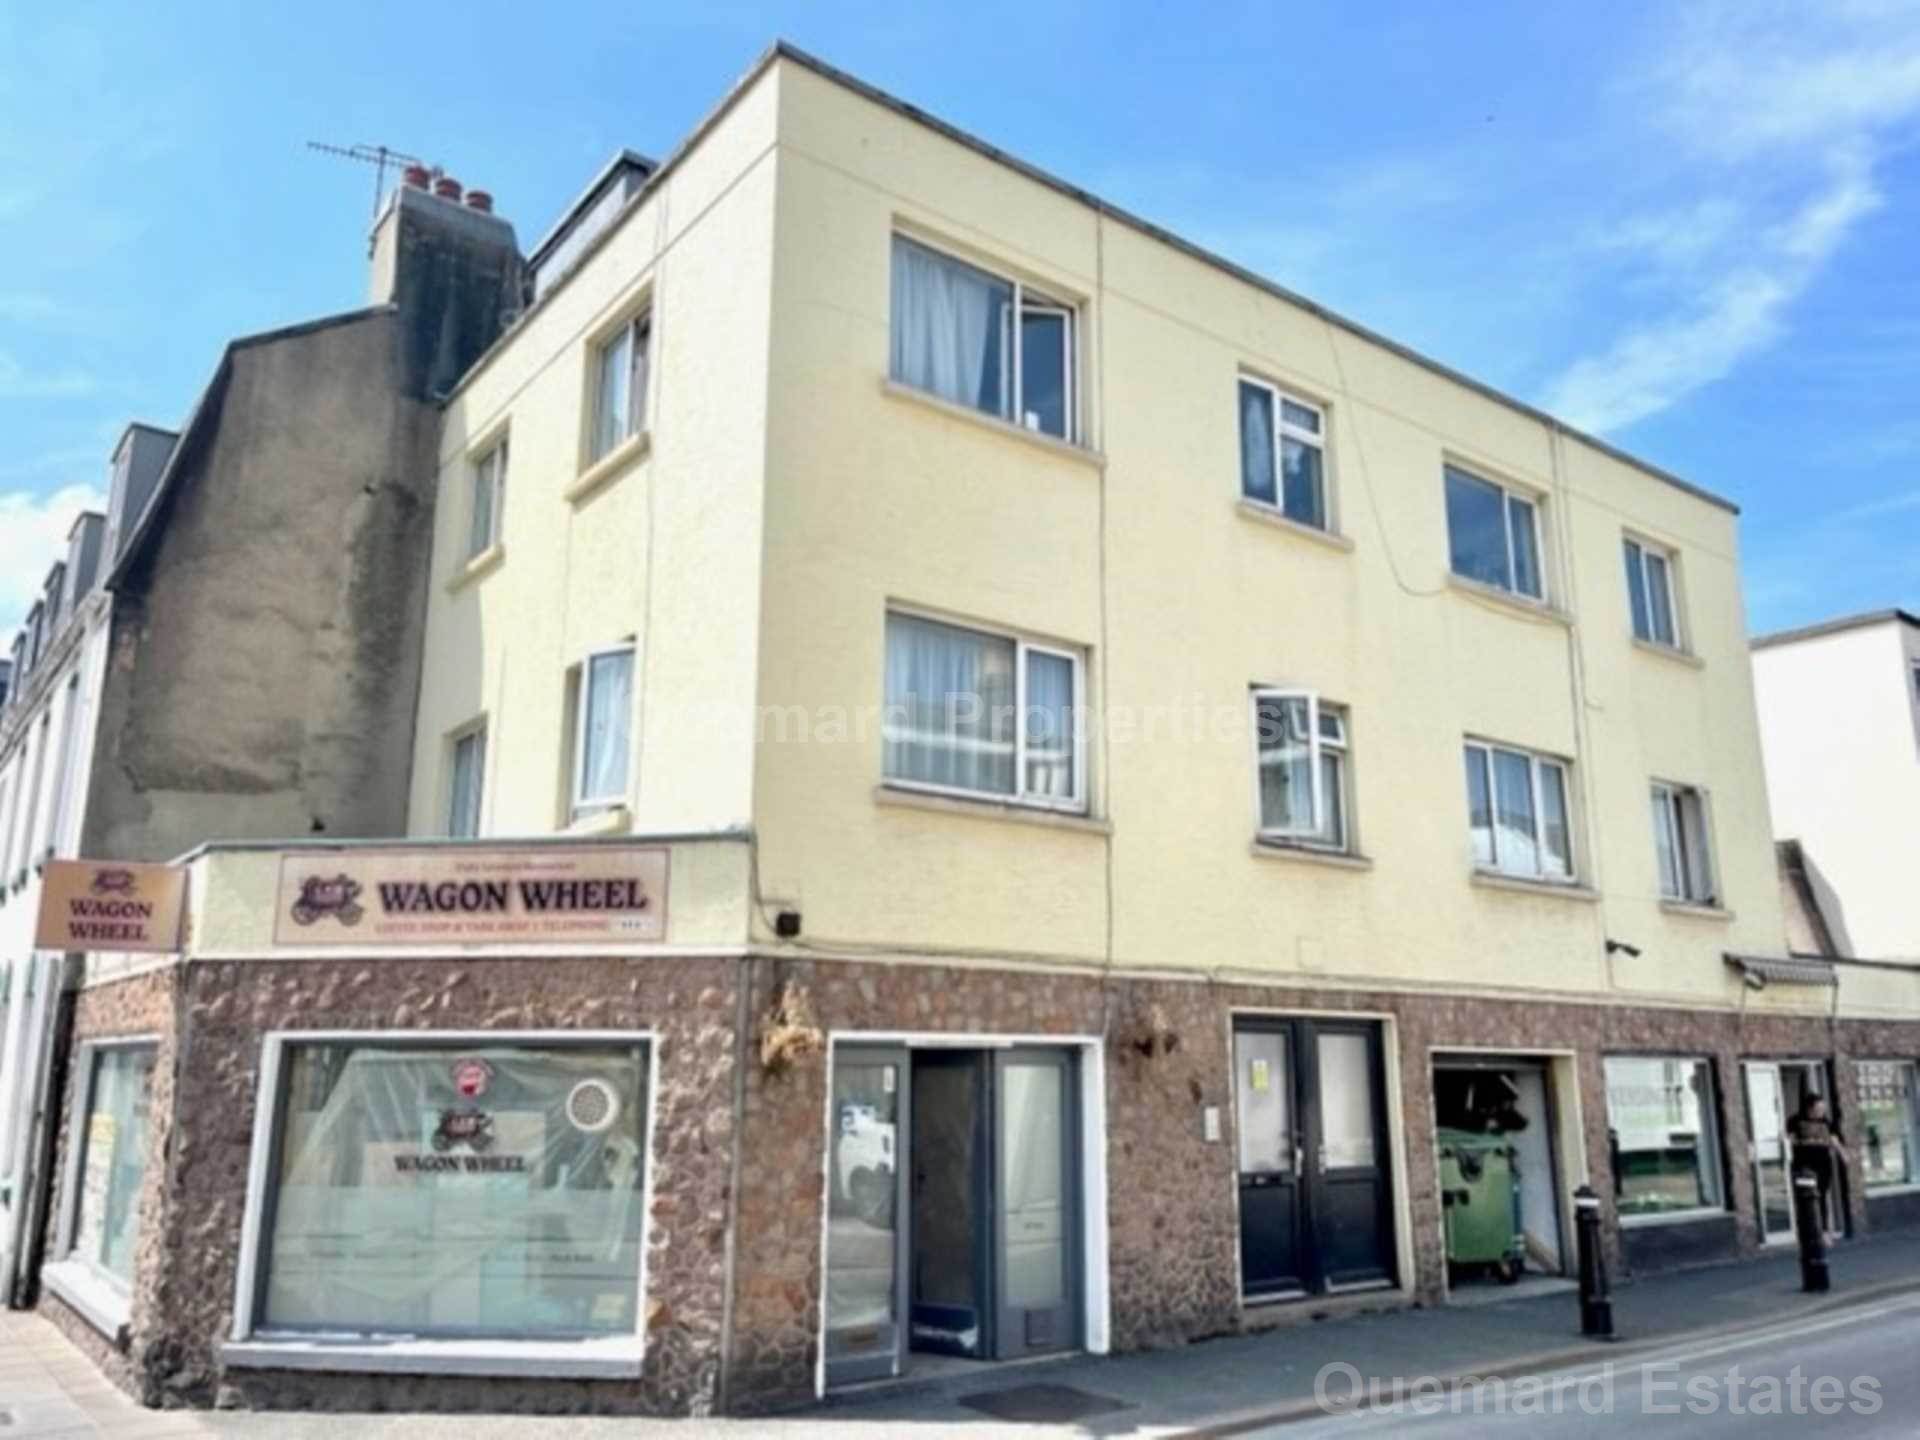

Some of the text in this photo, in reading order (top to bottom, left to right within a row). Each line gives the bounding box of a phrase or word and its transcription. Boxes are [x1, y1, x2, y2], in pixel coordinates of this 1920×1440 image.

[379, 879, 648, 912] WAGON WHEEL
[70, 900, 152, 918] WAGON
[68, 923, 149, 940] WHEEL
[394, 1155, 526, 1172] WAGON WHEEL
